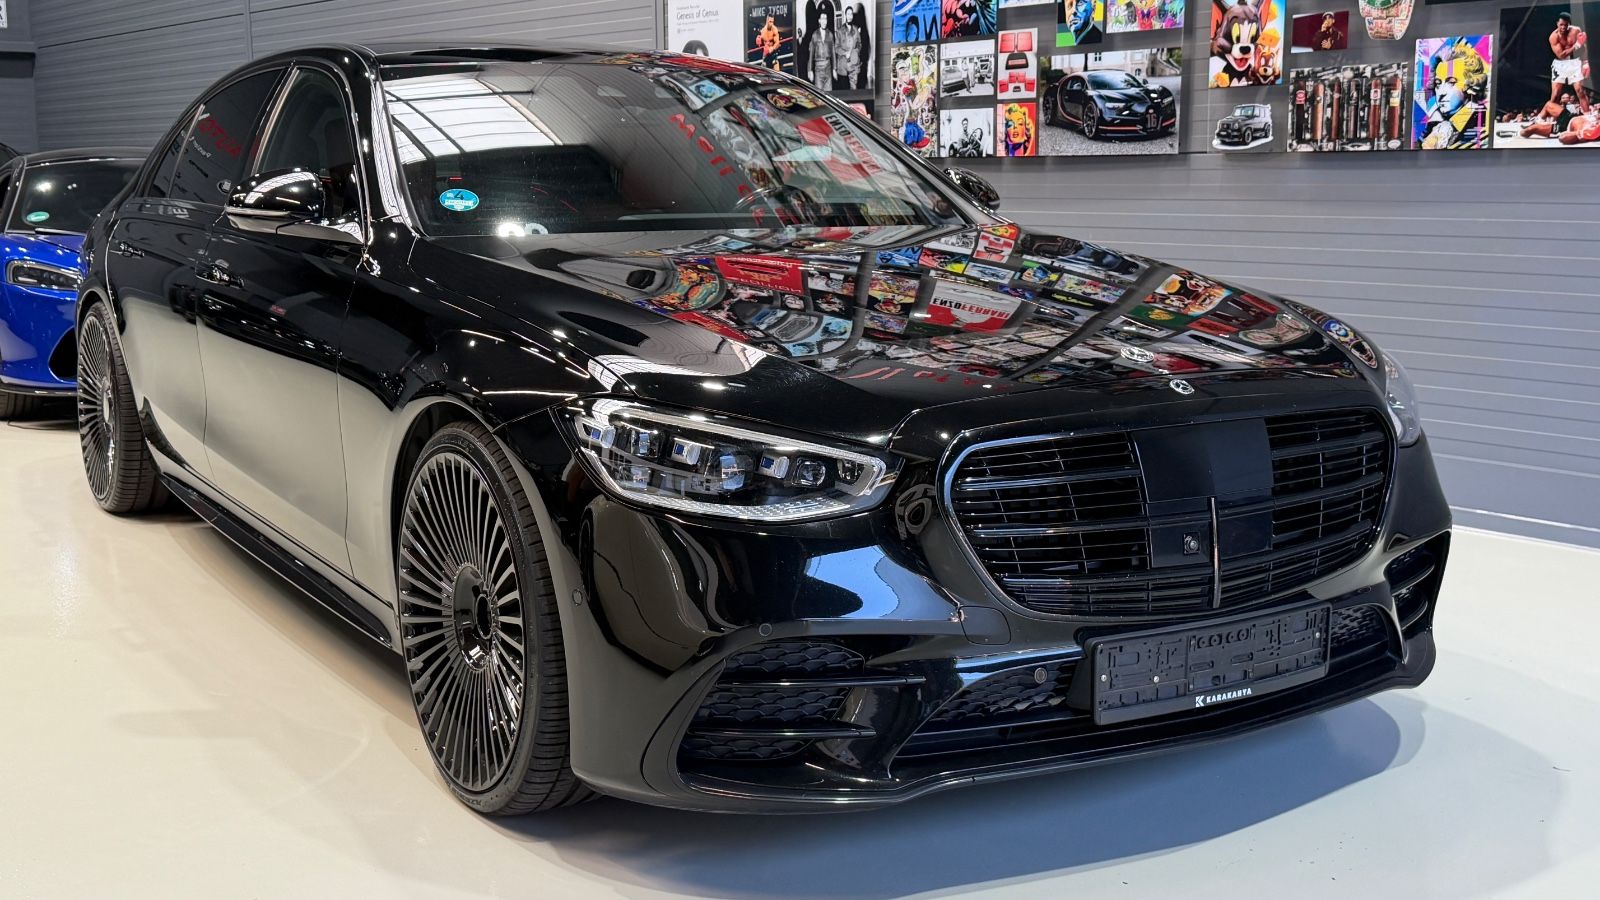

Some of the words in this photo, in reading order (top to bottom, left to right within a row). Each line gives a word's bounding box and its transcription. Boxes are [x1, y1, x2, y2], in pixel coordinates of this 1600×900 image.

[752, 7, 766, 17] MIKE
[769, 5, 787, 15] TYSON
[1146, 114, 1157, 128] 16
[453, 190, 464, 200] 4
